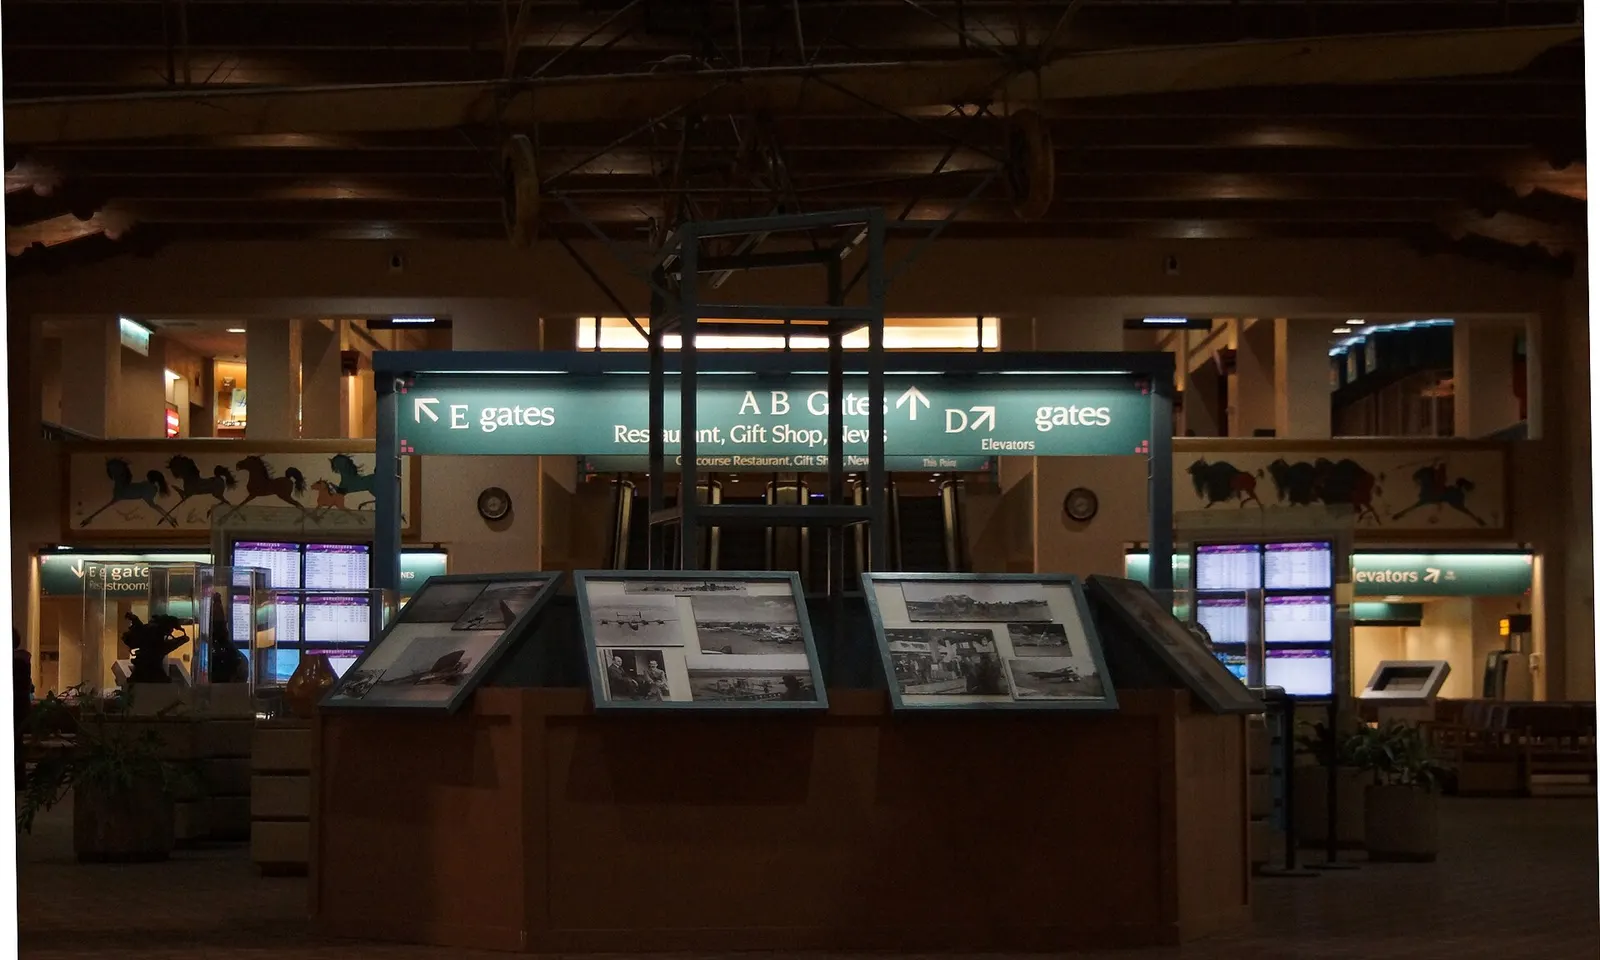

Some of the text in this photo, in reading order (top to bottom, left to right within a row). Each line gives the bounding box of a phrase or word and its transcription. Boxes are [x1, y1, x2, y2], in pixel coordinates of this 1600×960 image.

[738, 390, 888, 416] A B Gte
[450, 404, 556, 433] E gates
[944, 404, 1111, 433] D gates
[613, 423, 888, 448] Resaunt, Gift Shop, ew
[981, 438, 1035, 451] Elevators
[675, 455, 870, 467] Ccourse Restaurant, Gift Sh, New
[111, 565, 149, 580] gate
[1351, 566, 1419, 583] levators
